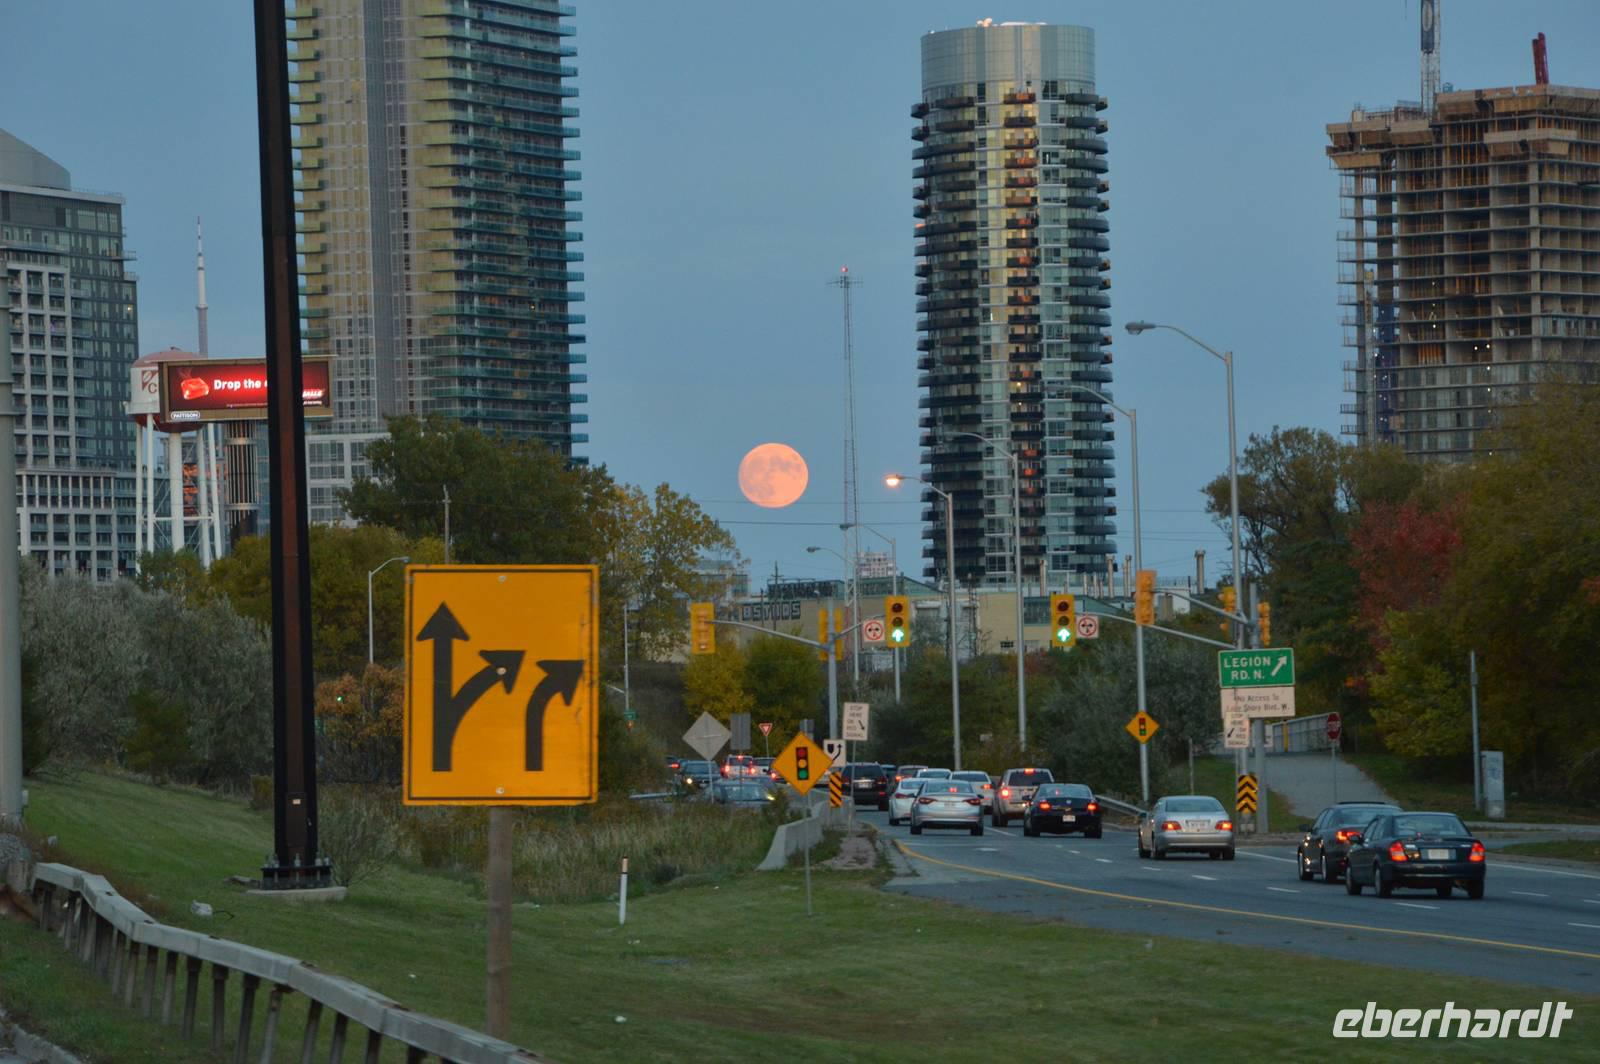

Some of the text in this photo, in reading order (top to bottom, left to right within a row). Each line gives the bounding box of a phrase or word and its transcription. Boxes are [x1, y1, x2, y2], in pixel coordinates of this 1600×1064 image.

[213, 379, 241, 391] Drop
[243, 378, 262, 389] the
[1223, 656, 1272, 669] LEGION
[1231, 669, 1265, 681] RD. N.
[1281, 703, 1290, 711] W.
